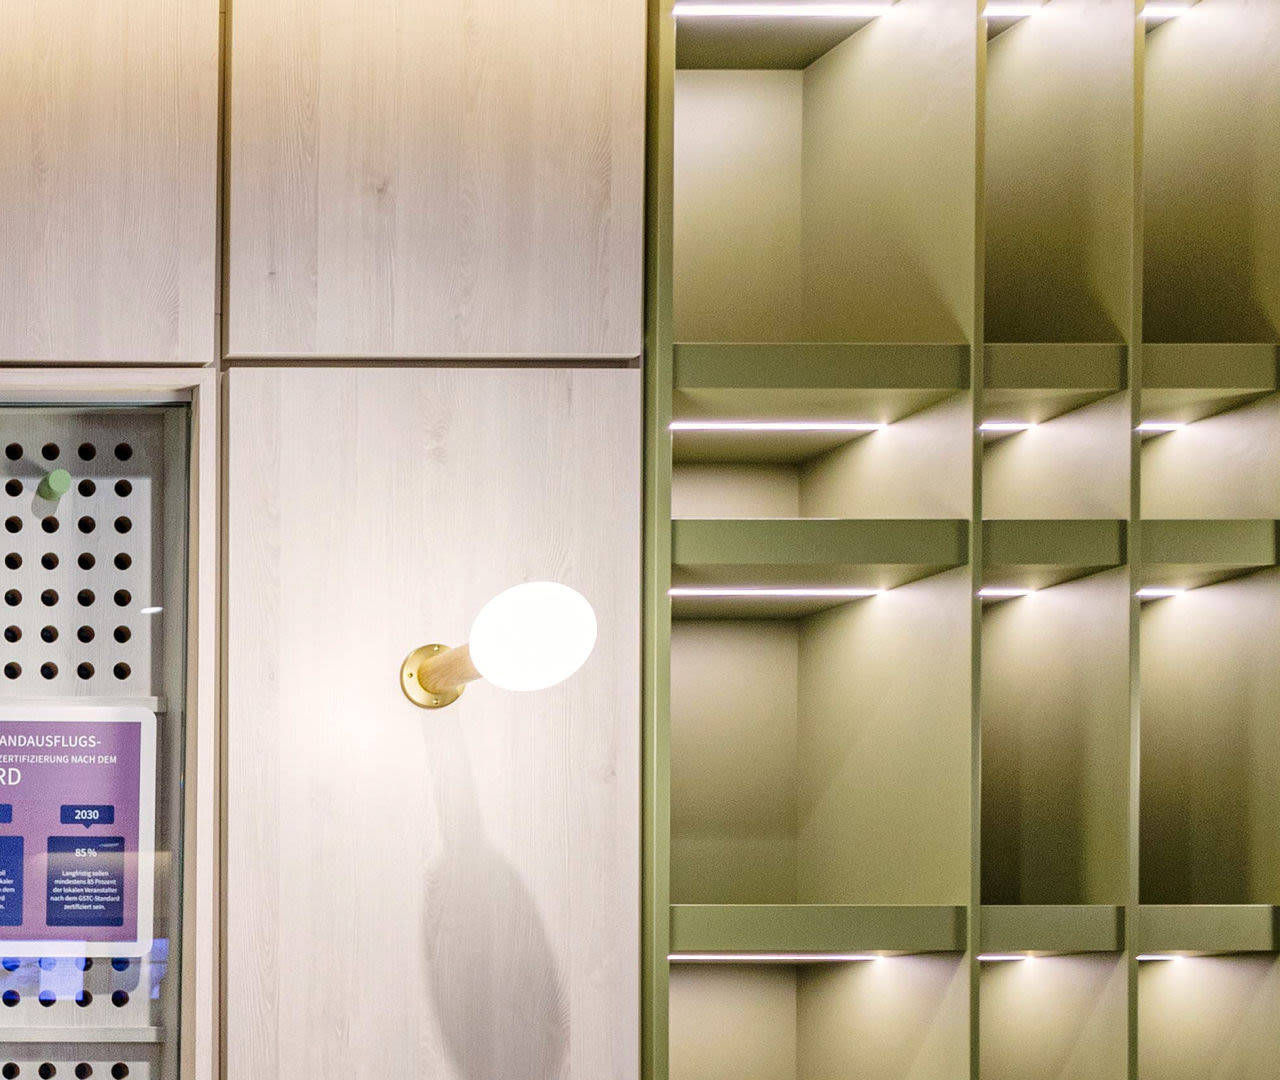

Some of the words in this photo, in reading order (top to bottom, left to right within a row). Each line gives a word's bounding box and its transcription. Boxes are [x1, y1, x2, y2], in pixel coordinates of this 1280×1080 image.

[71, 754, 95, 764] NACH
[97, 754, 117, 764] DEM
[74, 810, 99, 819] 2030
